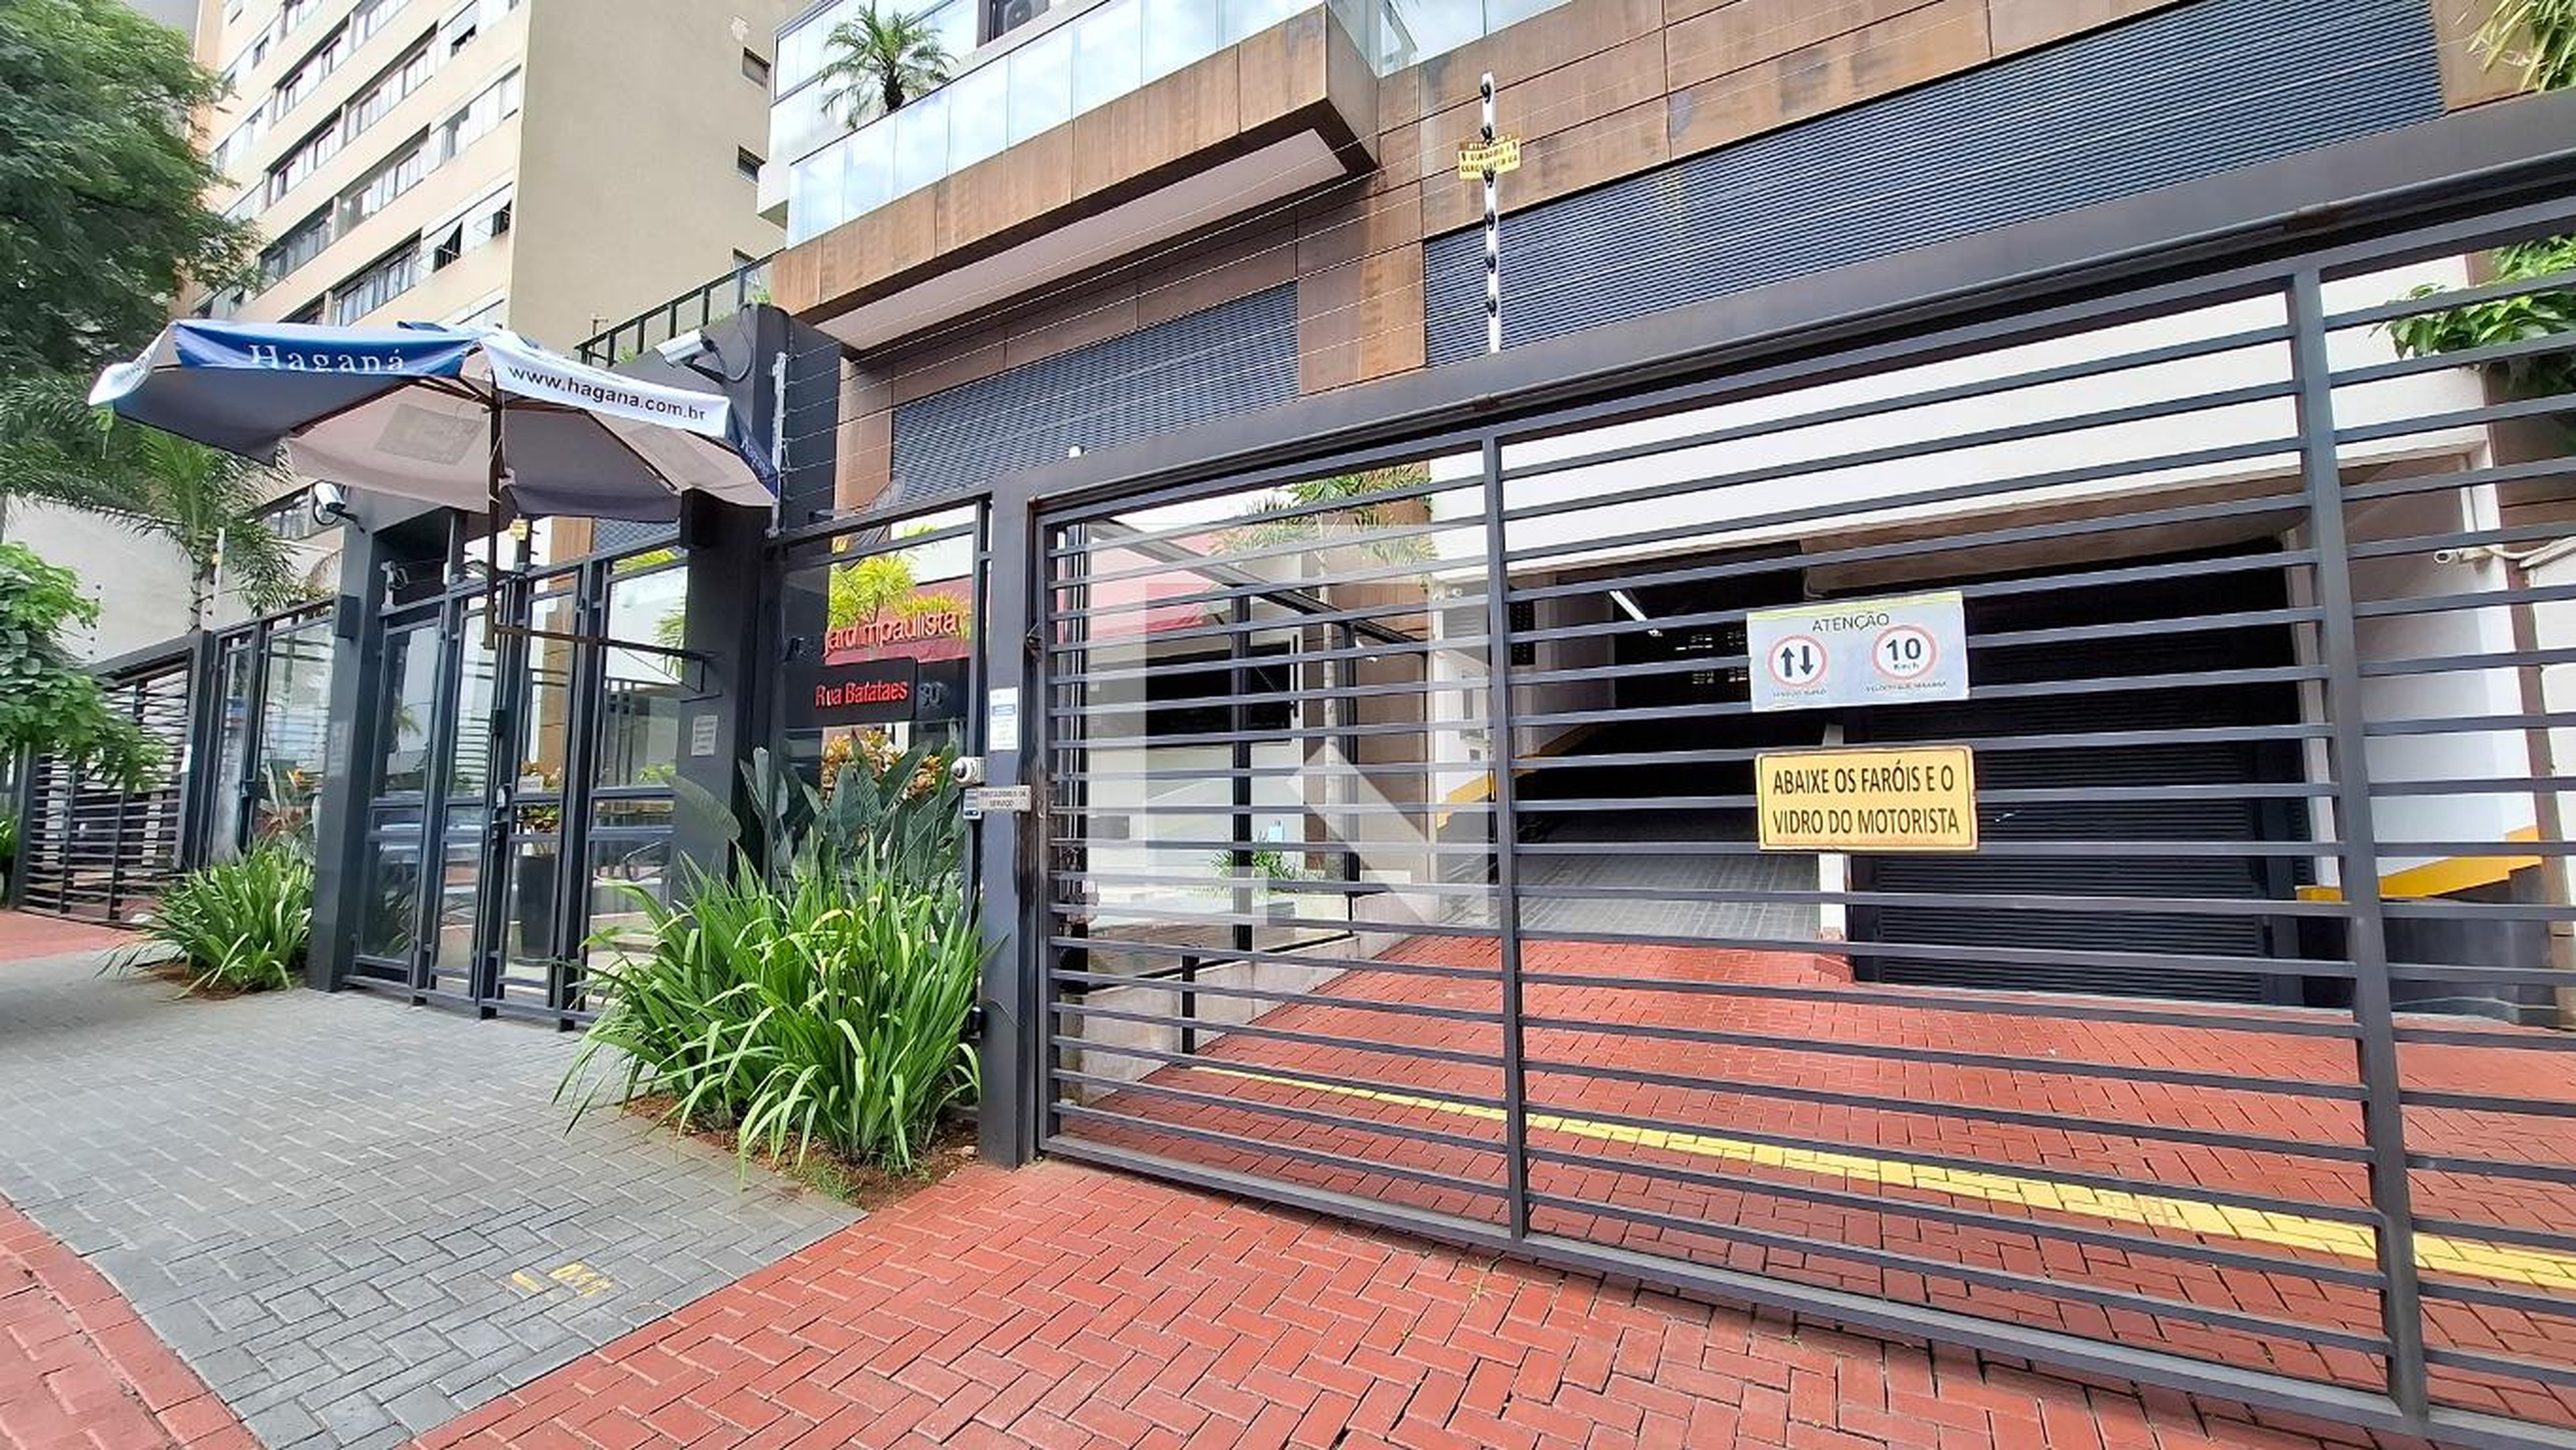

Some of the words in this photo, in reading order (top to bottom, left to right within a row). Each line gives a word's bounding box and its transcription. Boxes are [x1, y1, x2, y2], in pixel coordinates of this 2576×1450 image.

[249, 344, 404, 372] Haganá
[508, 366, 706, 421] www.hagana.com.br
[1813, 611, 1890, 632] ATENÇÃO
[1886, 638, 1921, 661] 10
[816, 685, 842, 707] Rua
[1773, 768, 1829, 794] ABAIXE
[1835, 768, 1856, 793] OS
[1862, 759, 1921, 792] FARÓIS
[1927, 766, 1935, 791] E
[1941, 765, 1954, 791] O
[1773, 809, 1823, 834] VIDRO
[1829, 809, 1852, 834] DO
[1858, 807, 1960, 834] MOTORISTA
